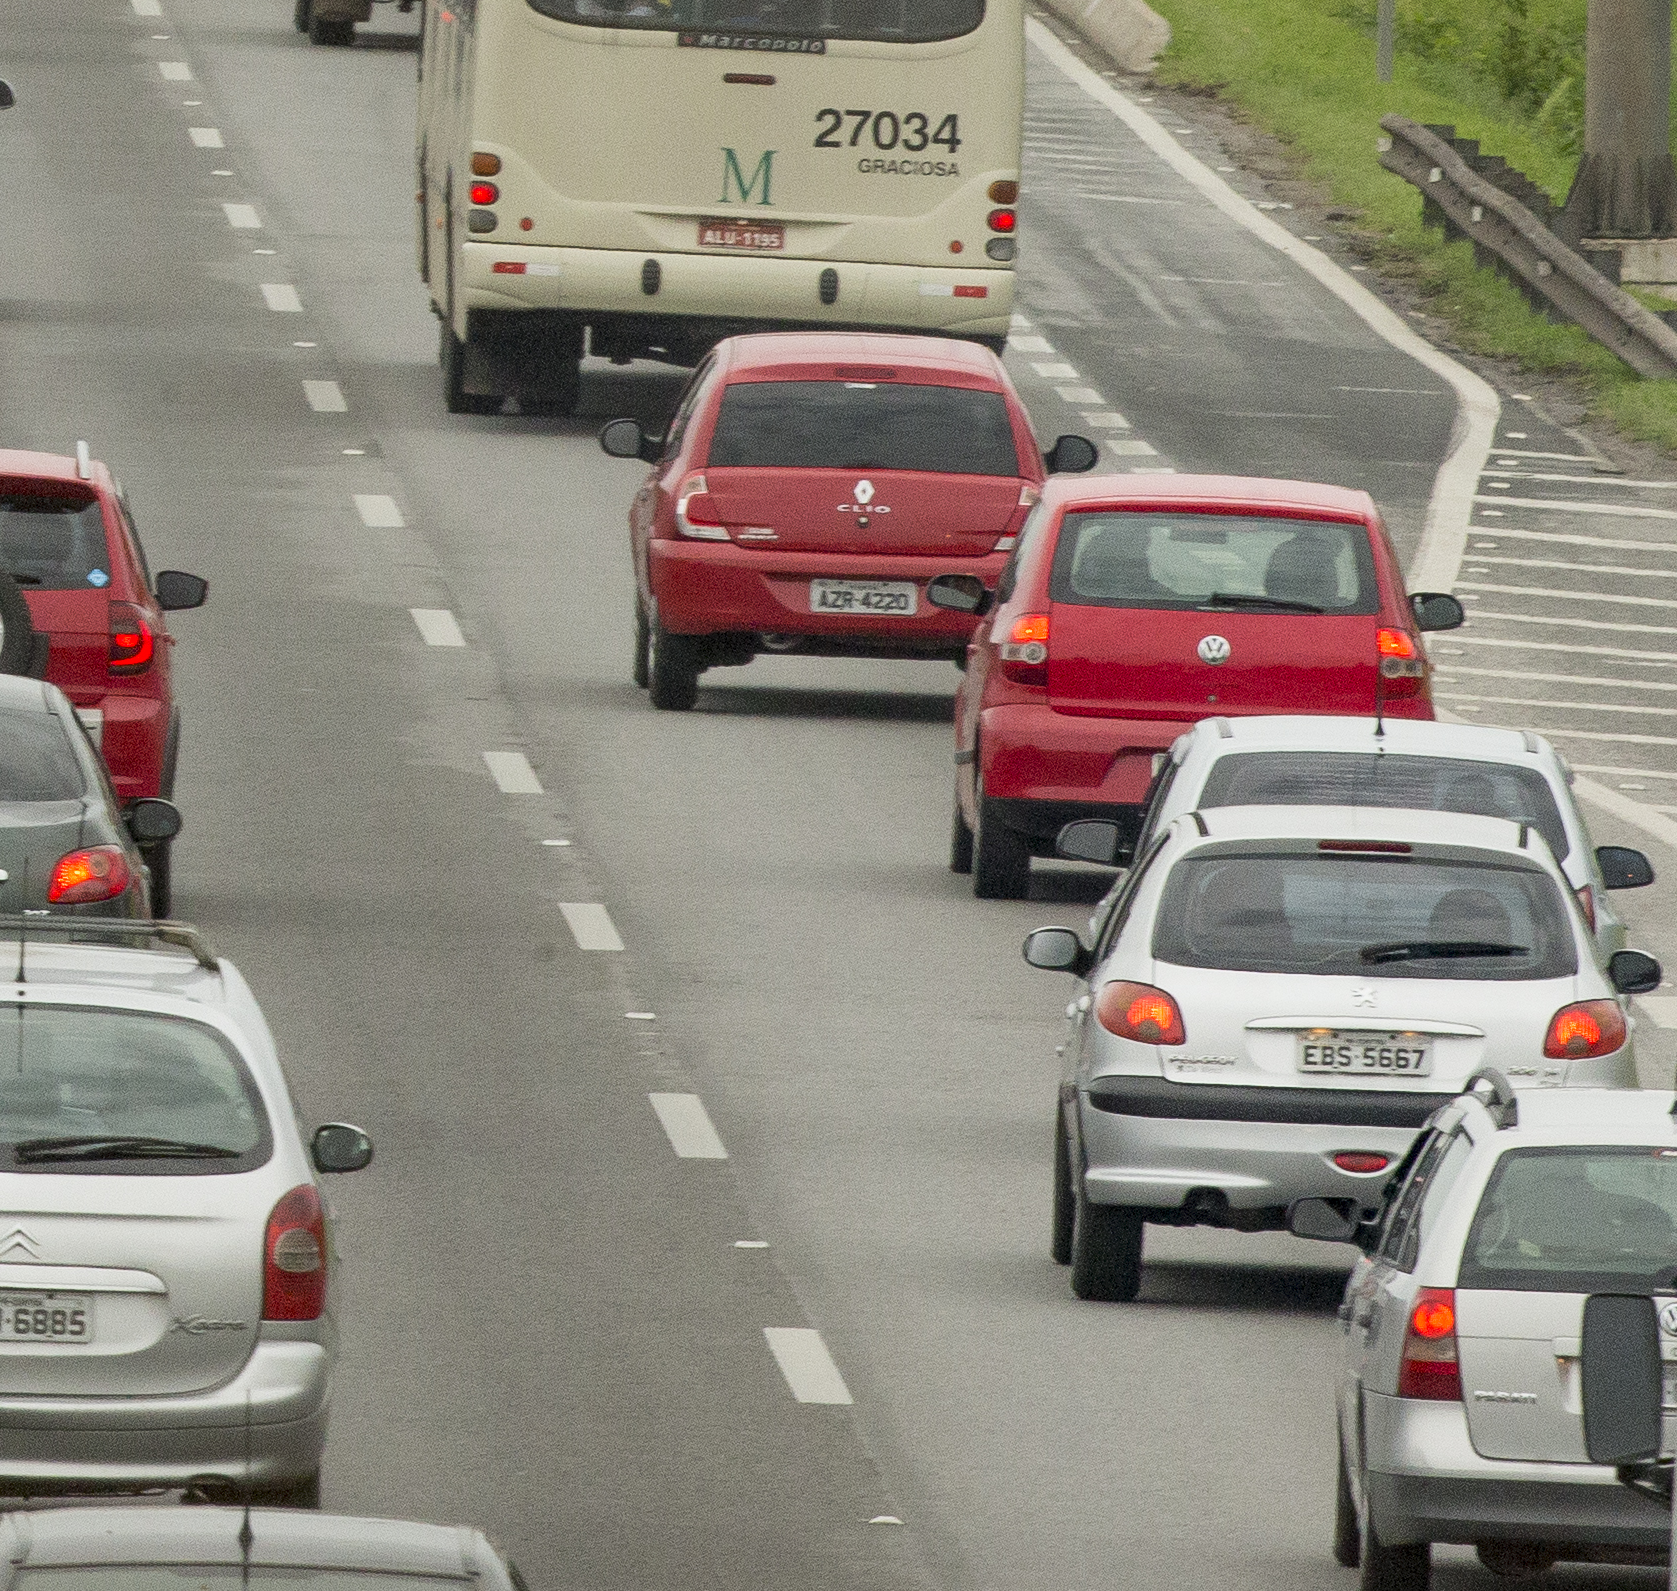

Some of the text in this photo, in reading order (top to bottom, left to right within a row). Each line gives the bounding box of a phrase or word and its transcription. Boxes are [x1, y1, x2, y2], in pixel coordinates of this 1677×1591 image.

[698, 34, 823, 52] Marcopolo
[813, 107, 963, 154] 27034
[715, 146, 779, 206] M
[857, 157, 961, 177] GRACIOSA
[836, 503, 891, 514] CLIO
